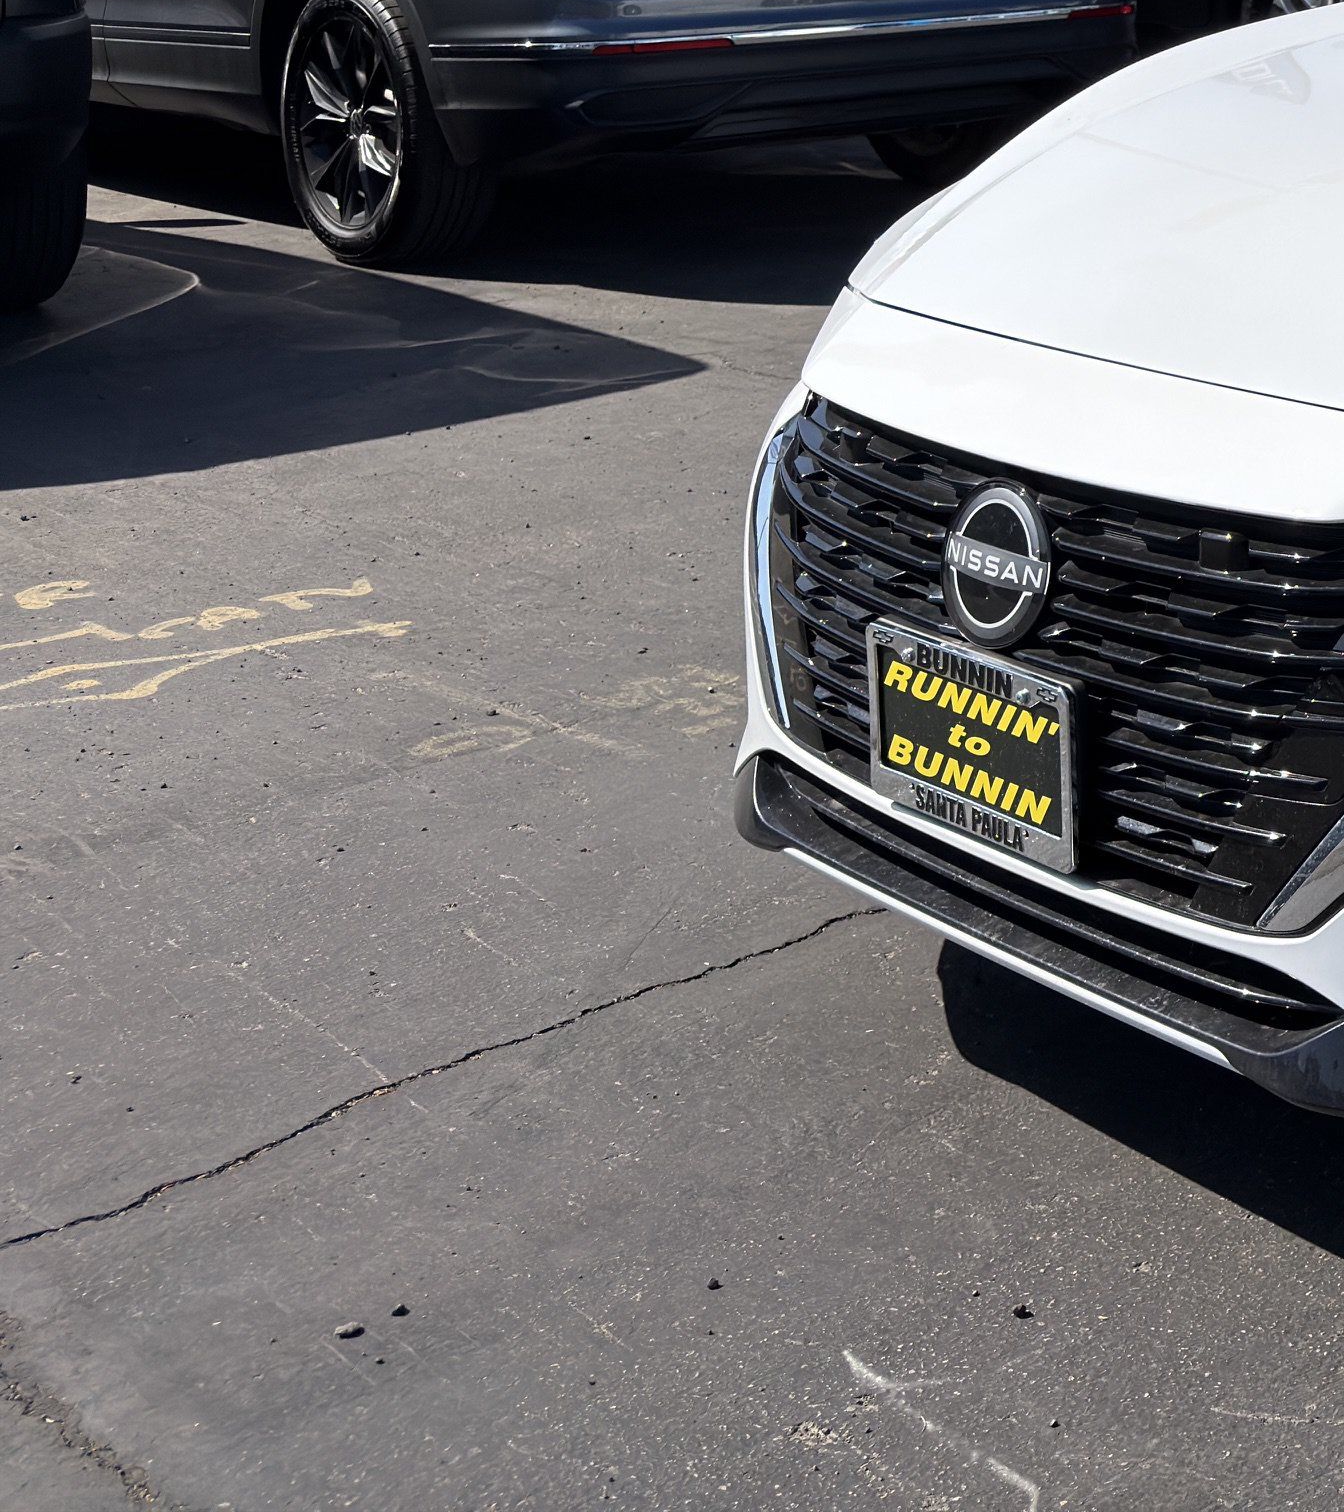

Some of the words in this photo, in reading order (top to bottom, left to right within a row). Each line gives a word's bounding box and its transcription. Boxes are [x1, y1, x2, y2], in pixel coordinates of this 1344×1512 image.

[947, 537, 1043, 589] NISSAN
[916, 642, 1014, 700] BUNNIN
[884, 660, 1060, 744] RUNNIN'
[948, 723, 991, 756] to
[887, 733, 1052, 825] BUNNIN
